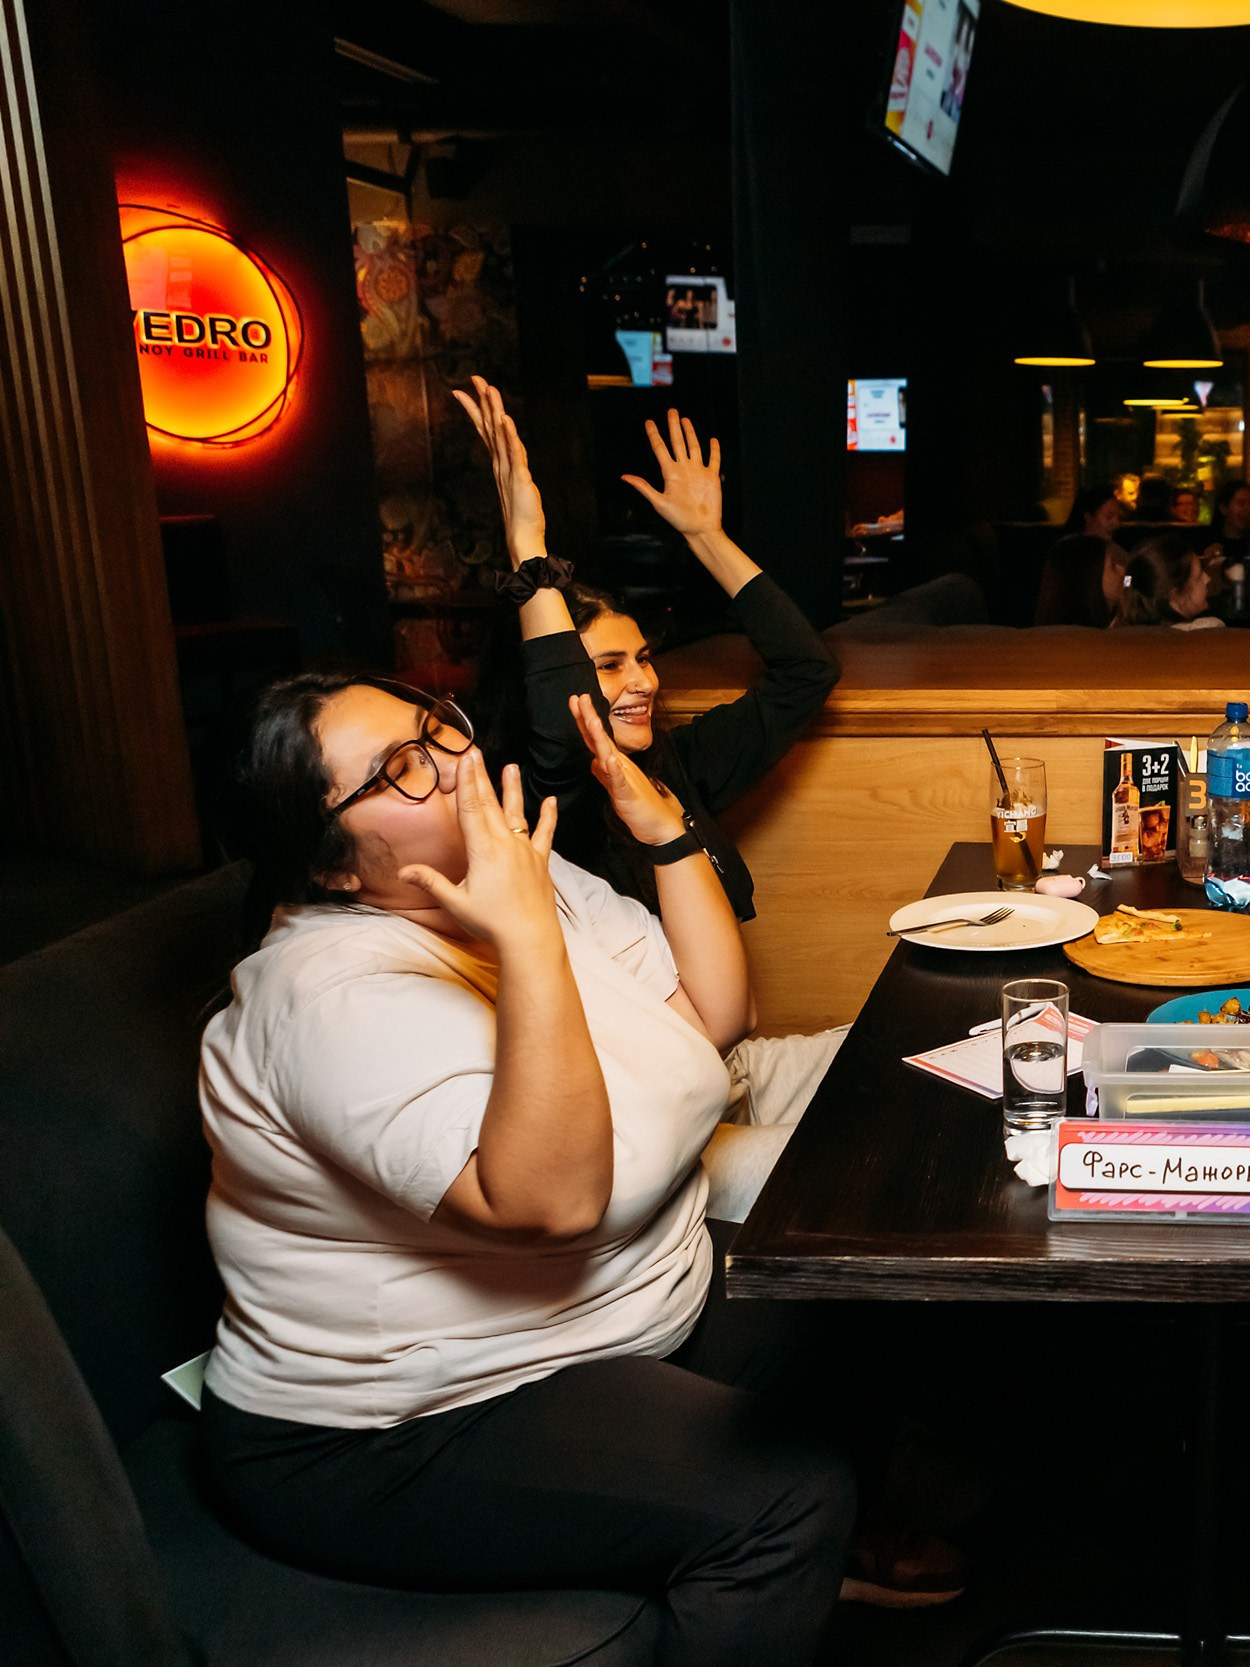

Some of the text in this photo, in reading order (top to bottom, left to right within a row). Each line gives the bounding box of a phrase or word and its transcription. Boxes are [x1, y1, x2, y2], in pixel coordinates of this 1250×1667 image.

[135, 311, 271, 349] EDRO
[184, 348, 229, 361] GRILL
[239, 352, 269, 364] BAR
[1142, 753, 1170, 776] 3+2
[1146, 783, 1169, 792] ПОДАРОК
